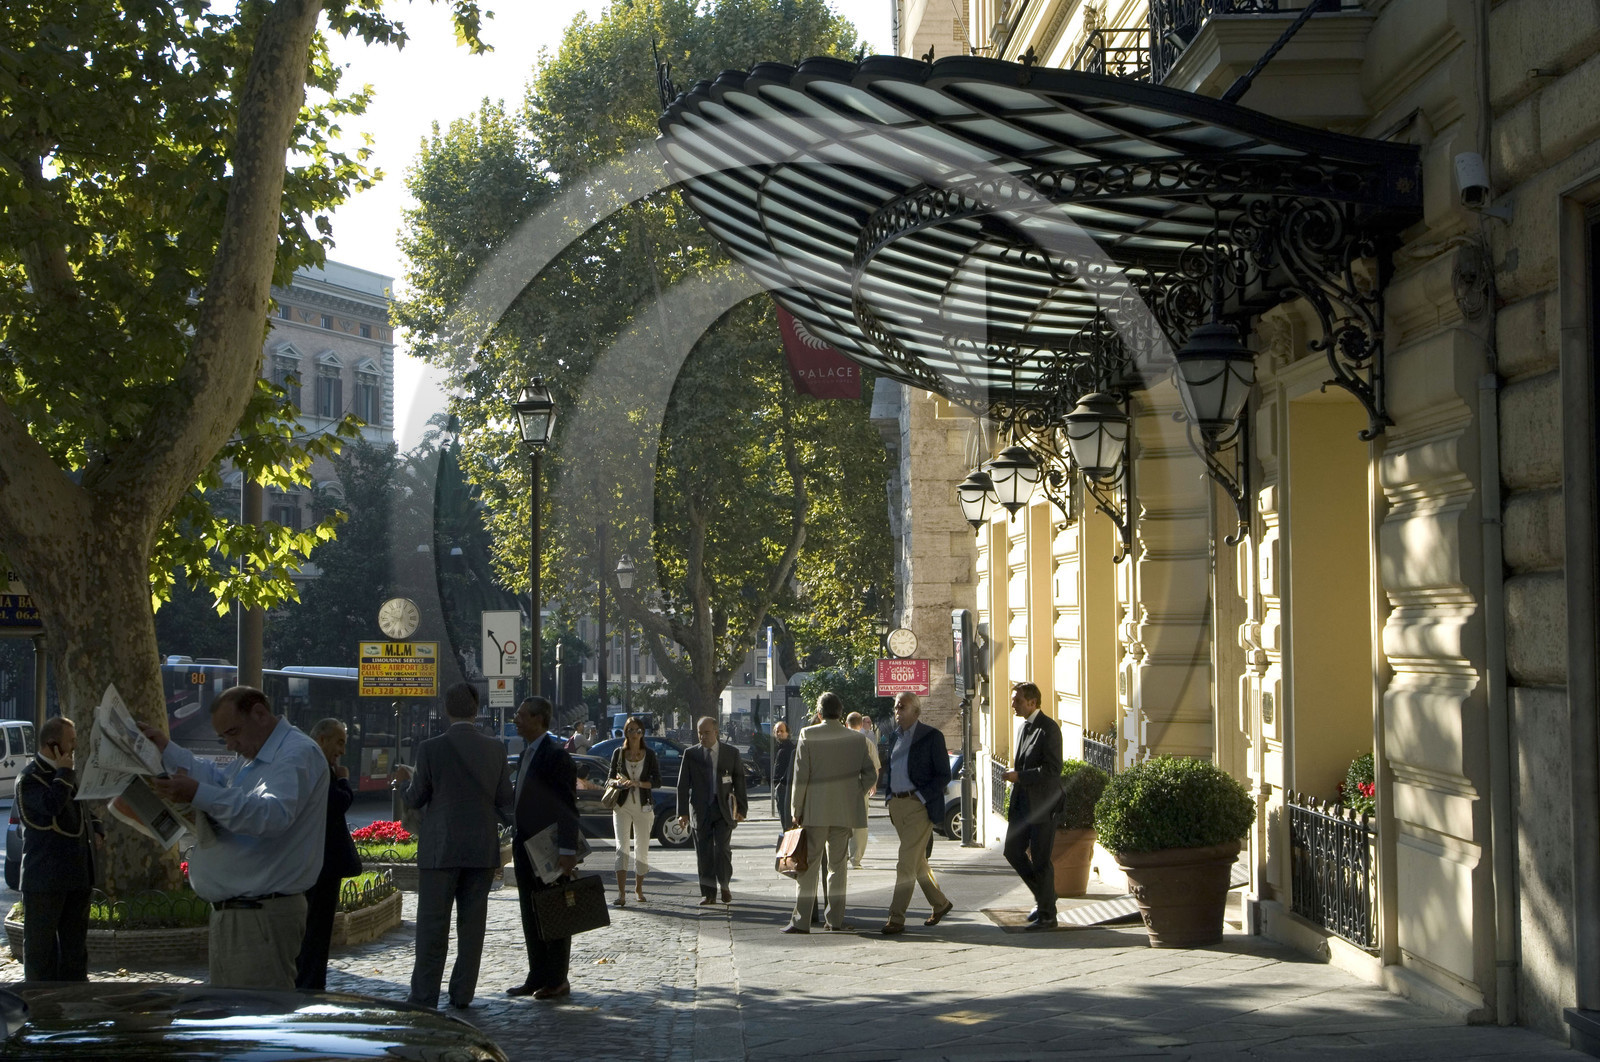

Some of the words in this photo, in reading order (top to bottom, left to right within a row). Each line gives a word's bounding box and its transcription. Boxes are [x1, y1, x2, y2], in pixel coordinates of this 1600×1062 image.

[798, 366, 853, 379] PALACE
[384, 644, 412, 656] M.L.M
[191, 672, 206, 685] 80
[891, 673, 915, 682] BOOM
